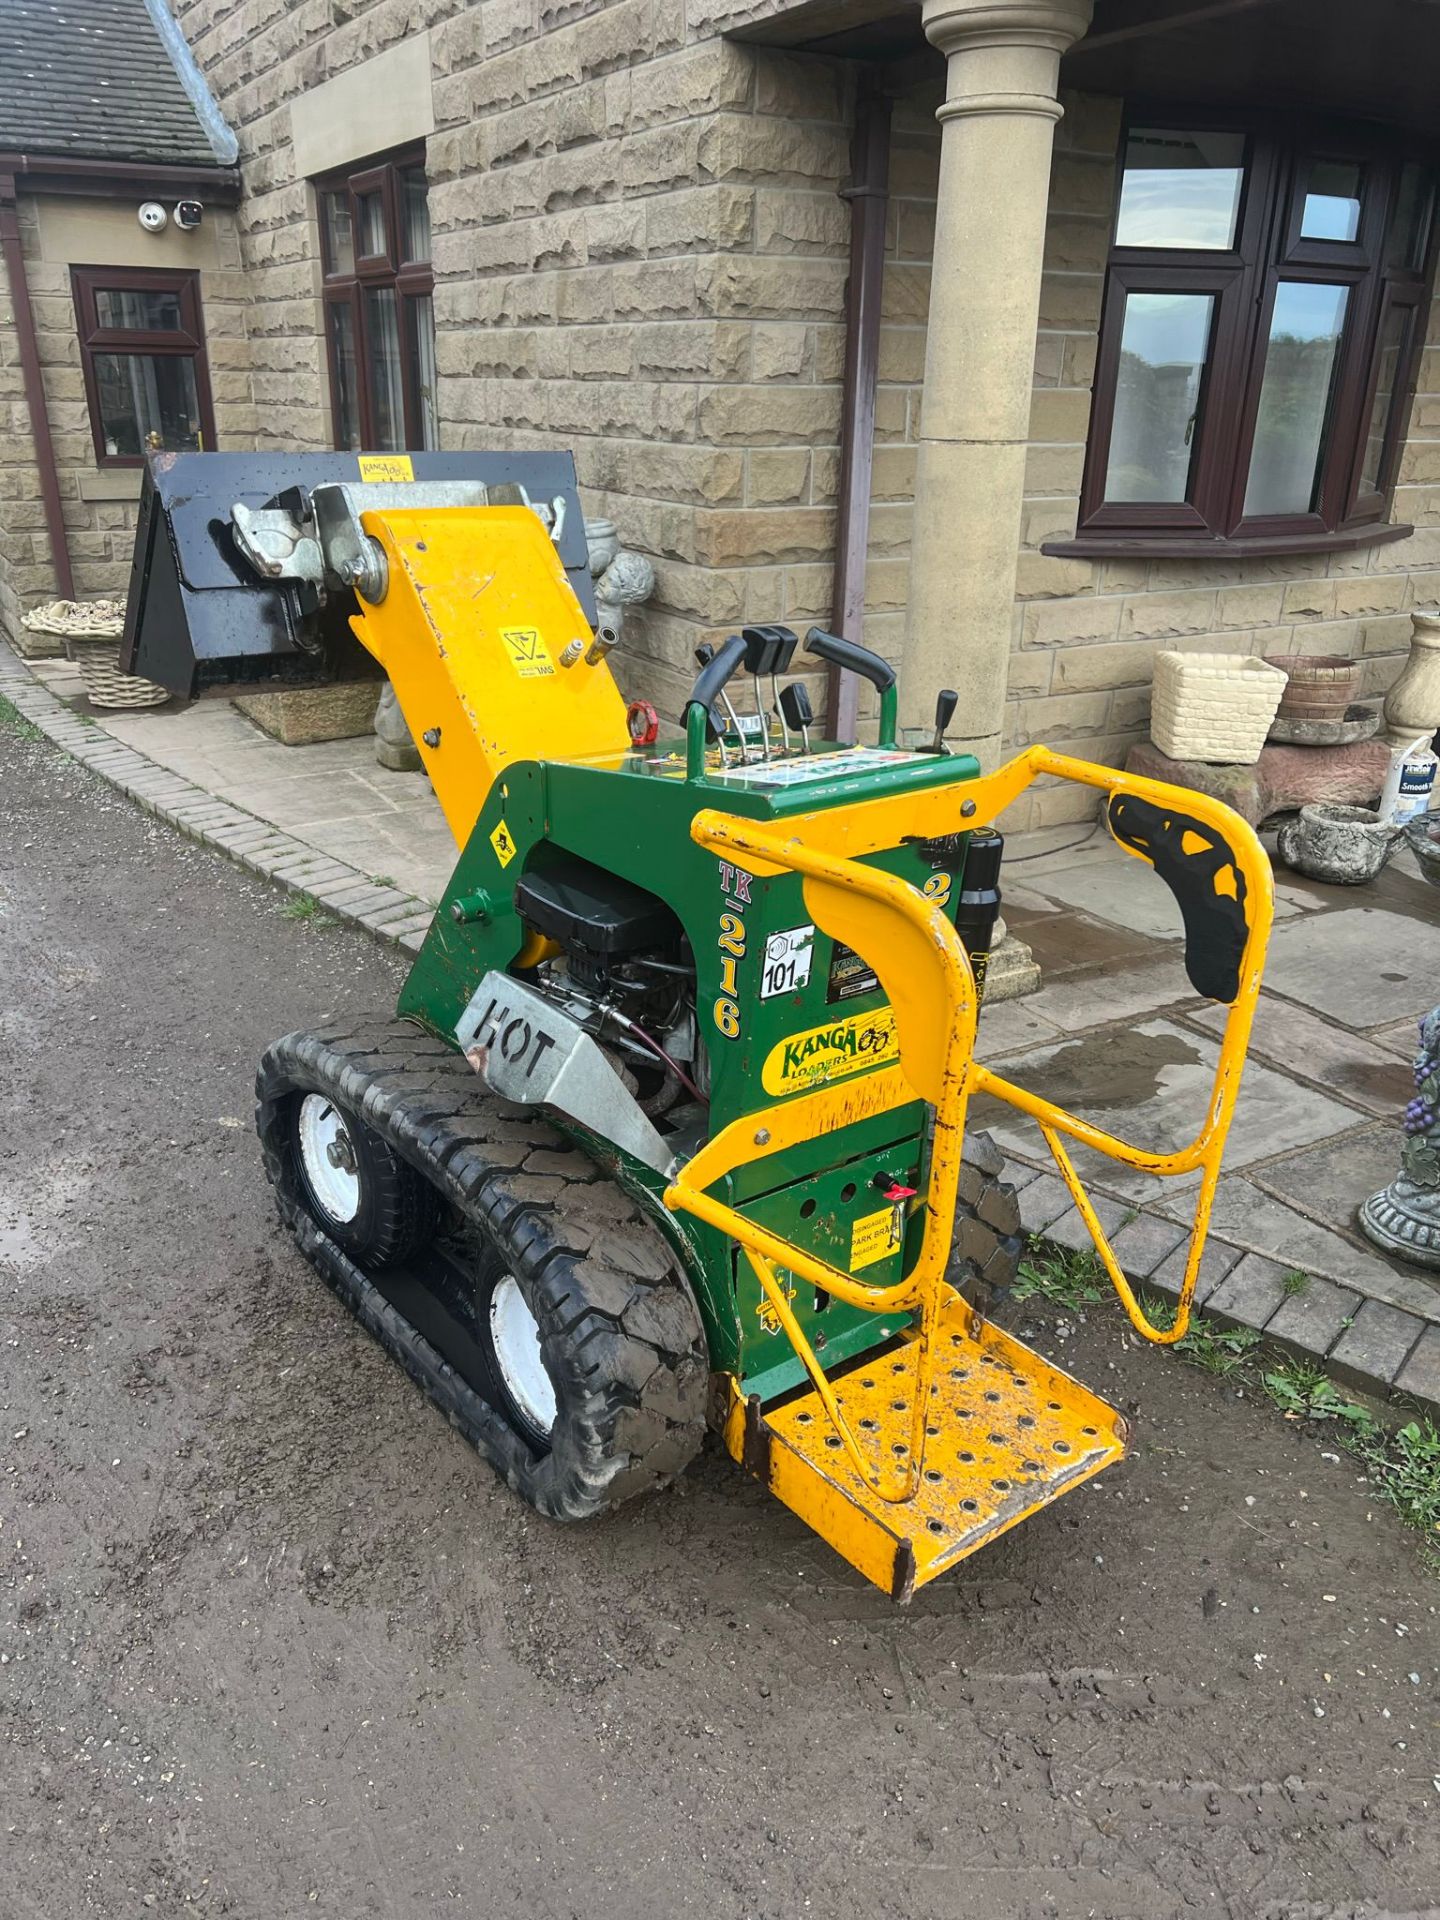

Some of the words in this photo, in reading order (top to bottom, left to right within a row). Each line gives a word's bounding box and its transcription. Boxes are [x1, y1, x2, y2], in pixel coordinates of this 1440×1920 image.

[1401, 782, 1428, 791] Smooth
[765, 959, 796, 993] 101
[472, 998, 556, 1078] HOT
[791, 1054, 848, 1079] LOADERS
[851, 1234, 872, 1246] PARK
